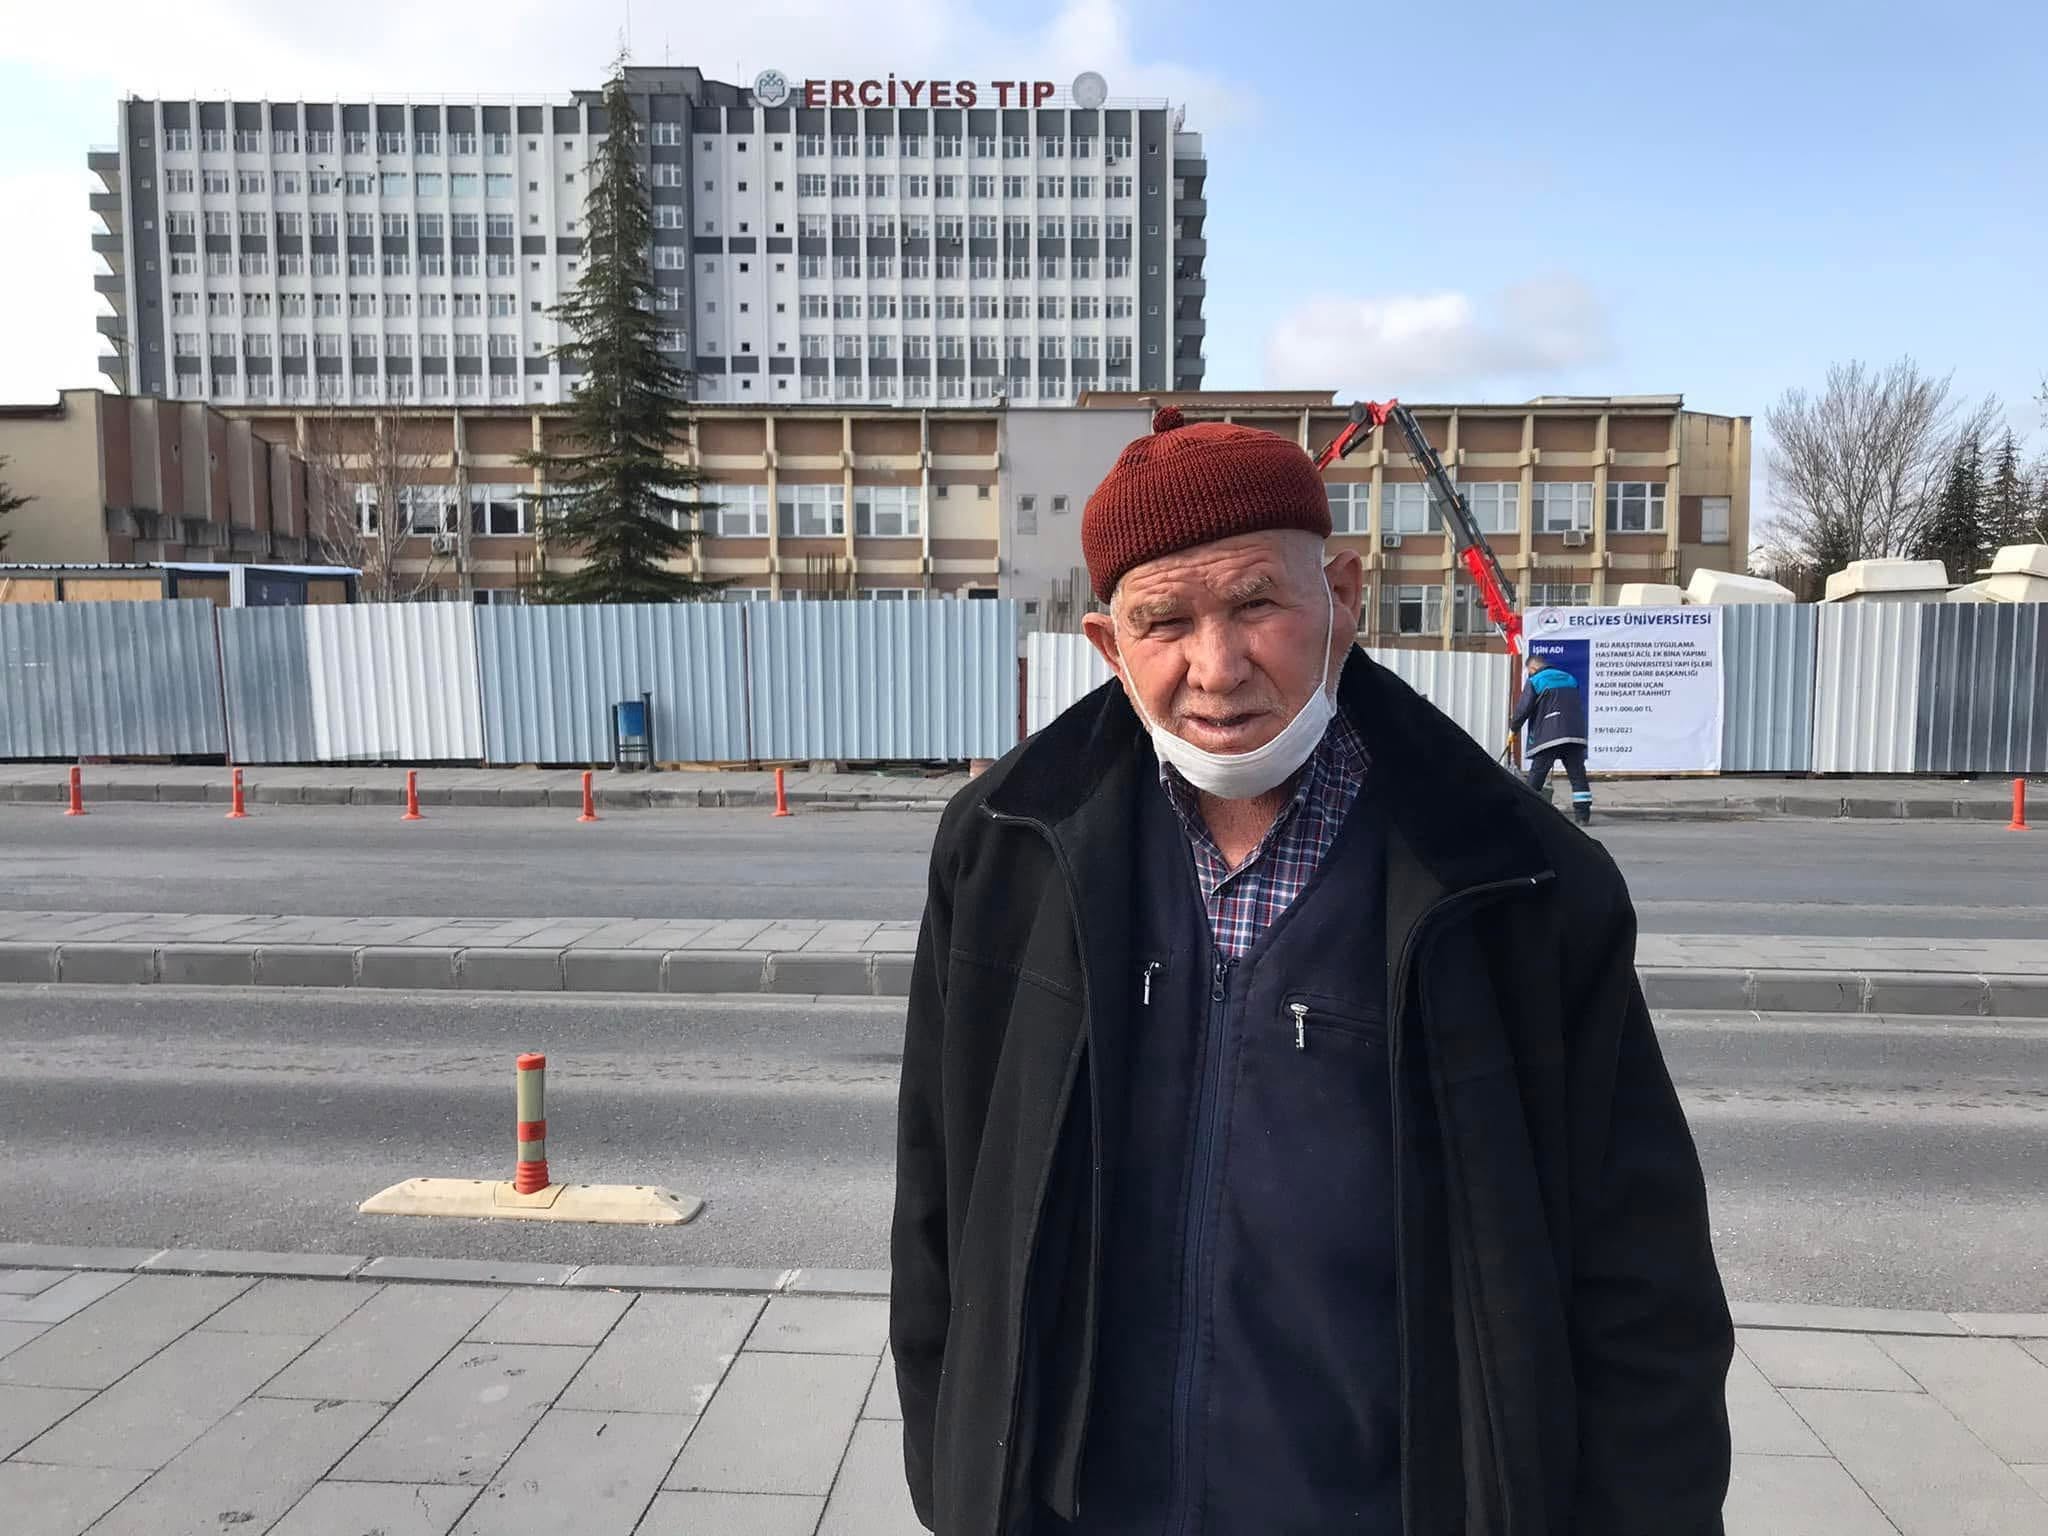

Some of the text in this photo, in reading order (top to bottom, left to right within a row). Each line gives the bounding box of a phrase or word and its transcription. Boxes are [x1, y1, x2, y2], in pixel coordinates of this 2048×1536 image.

[805, 73, 1055, 108] ERCİYES TIP
[1569, 612, 1711, 626] ERCİYES ÜNİVERSİTESİ
